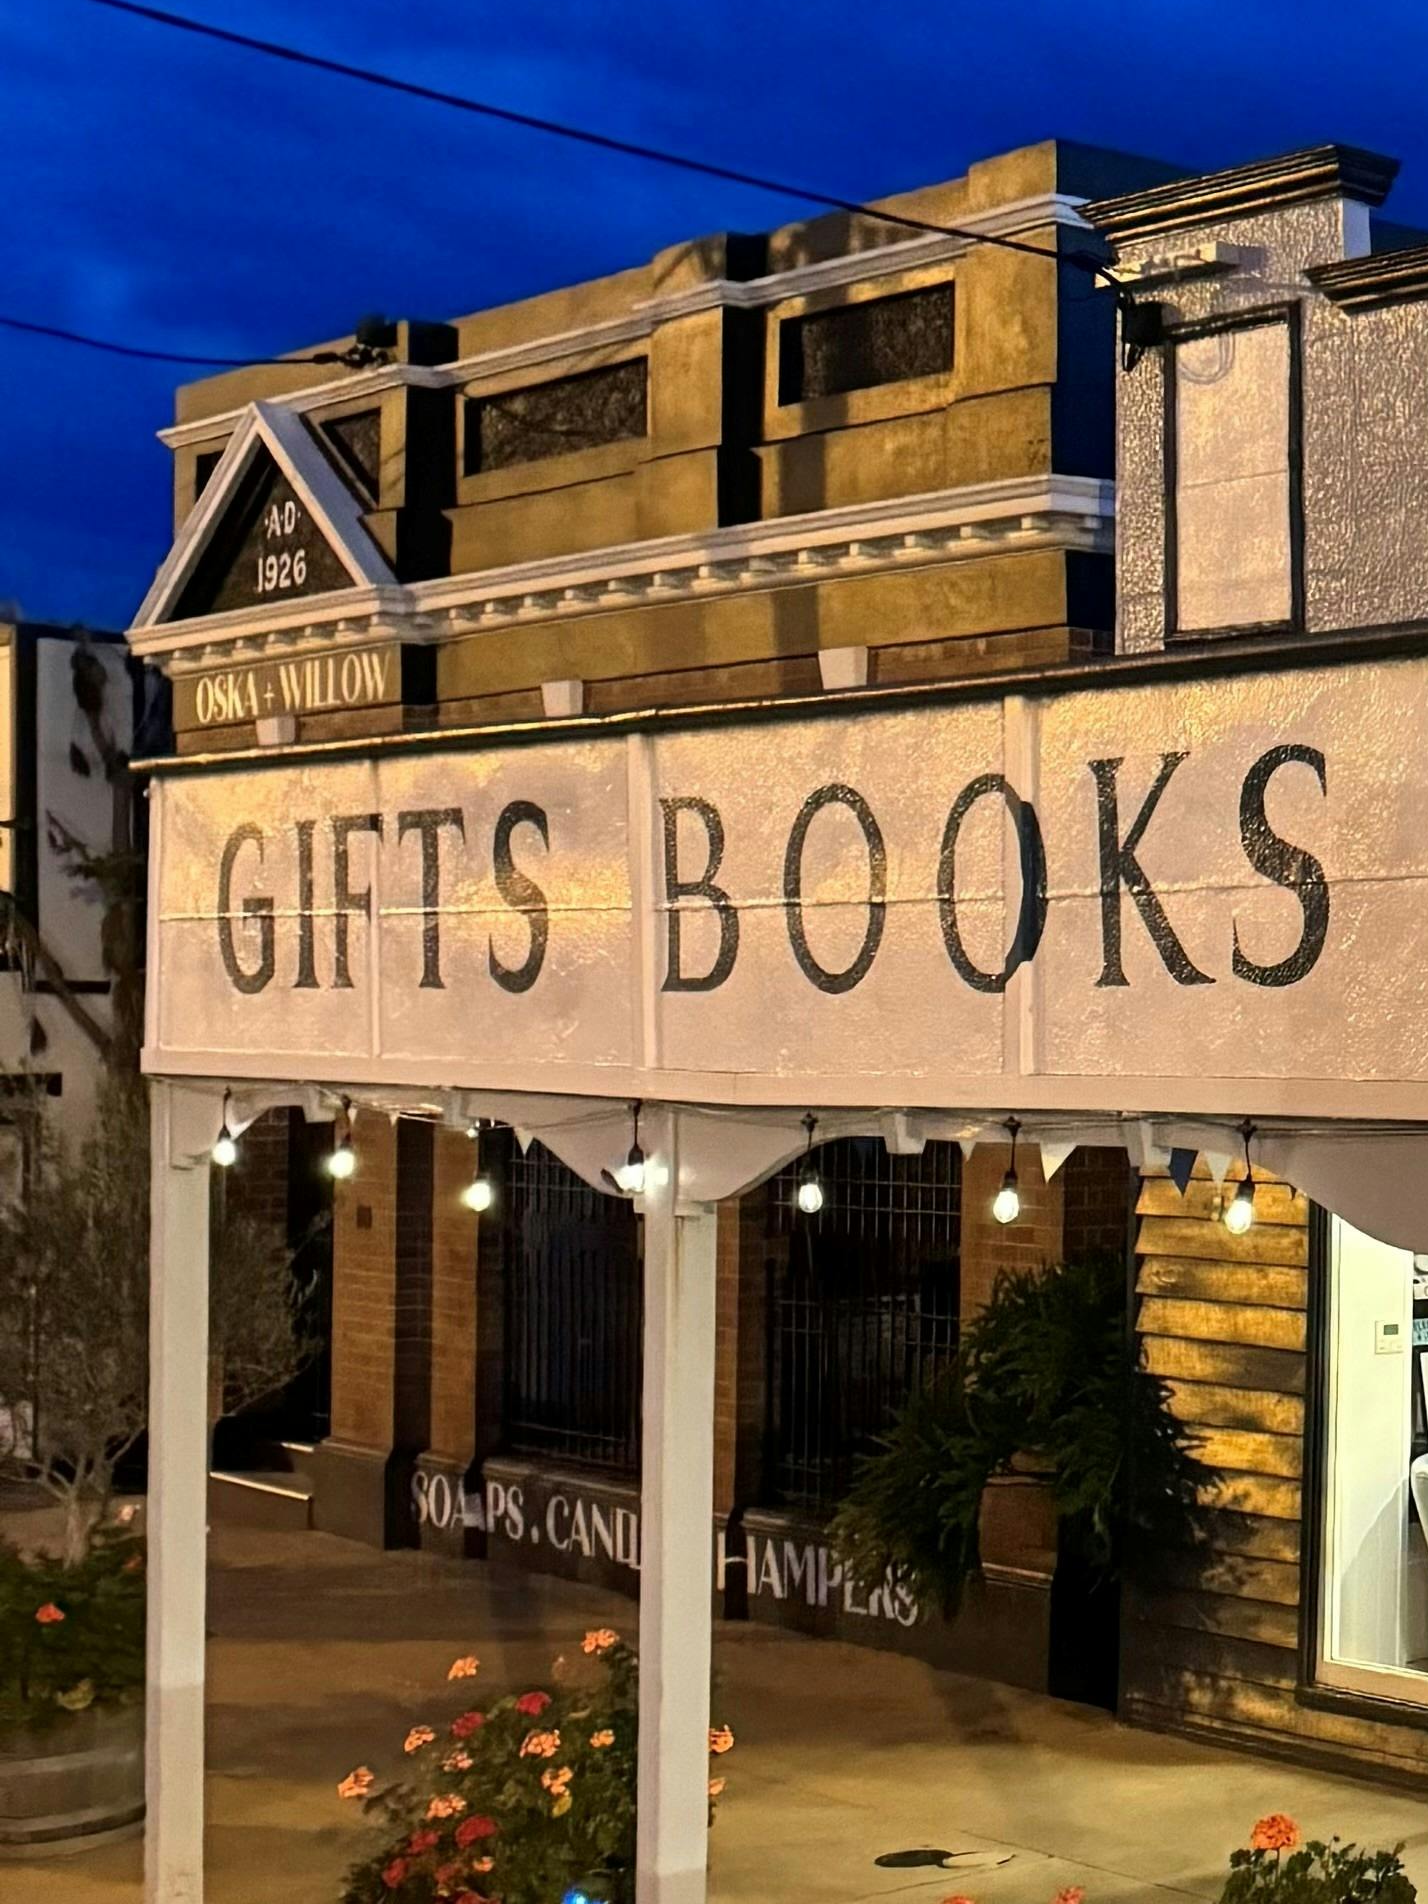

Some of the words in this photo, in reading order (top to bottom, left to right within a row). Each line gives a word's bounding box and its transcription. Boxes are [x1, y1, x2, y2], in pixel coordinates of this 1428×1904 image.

[257, 548, 307, 592] 1926
[196, 671, 259, 724] OSKA
[279, 649, 390, 712] WILLOW
[217, 799, 550, 995] GIFTS
[657, 743, 1331, 995] BOOKS
